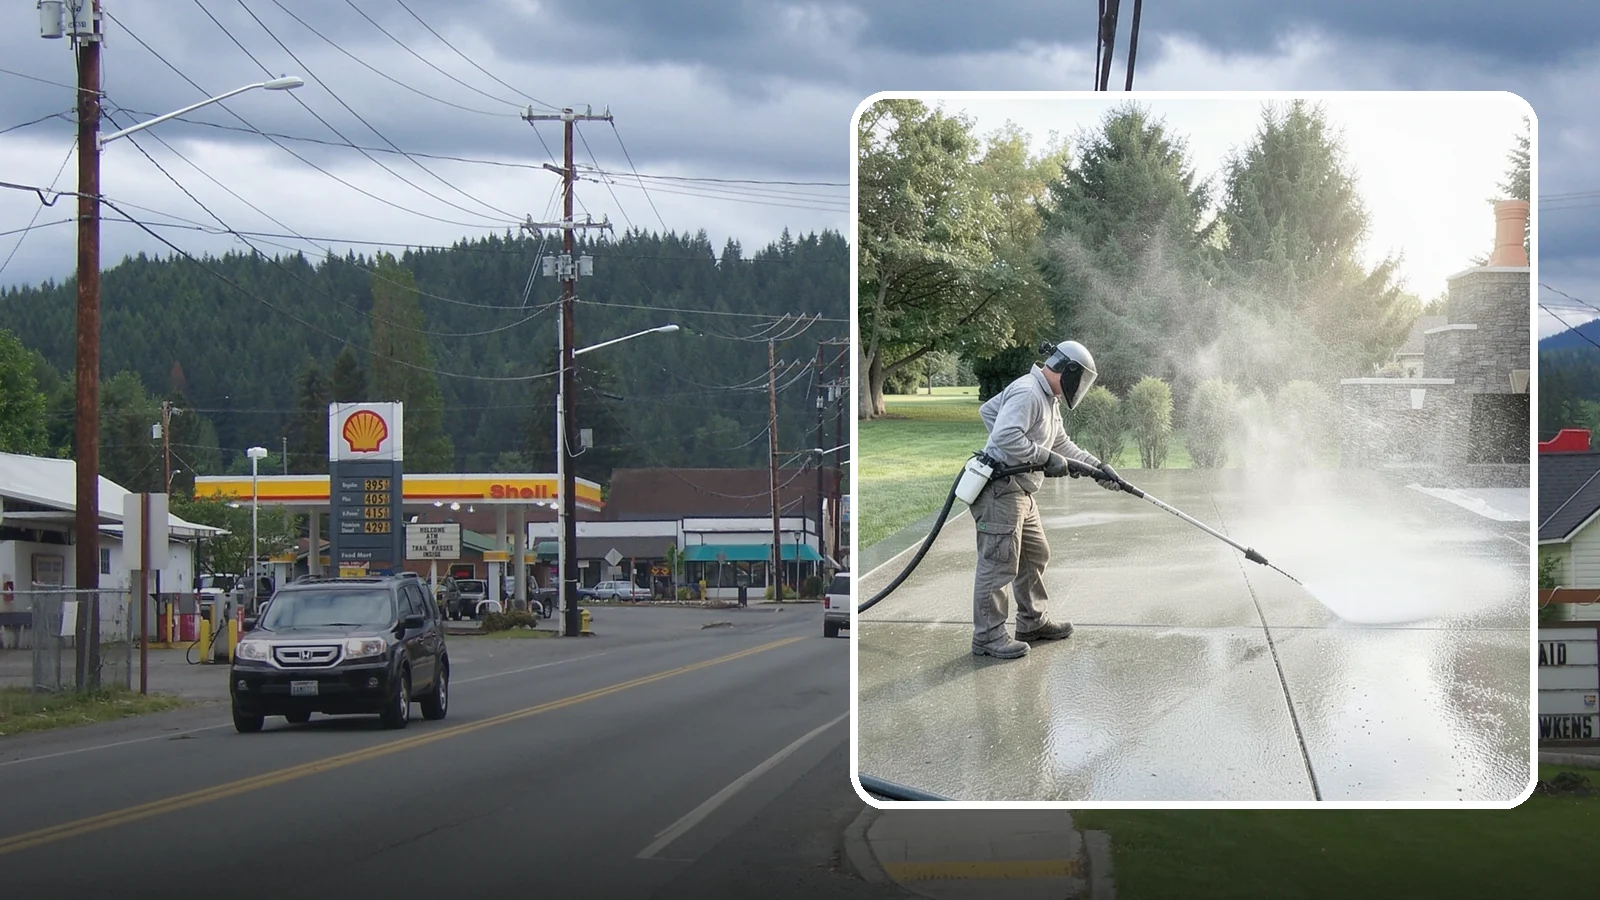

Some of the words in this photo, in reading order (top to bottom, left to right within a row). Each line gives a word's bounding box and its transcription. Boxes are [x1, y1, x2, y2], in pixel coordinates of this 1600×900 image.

[366, 480, 383, 490] 395
[490, 484, 547, 499] Shell
[366, 494, 383, 504] 405
[366, 508, 383, 518] 415
[366, 522, 383, 532] 429
